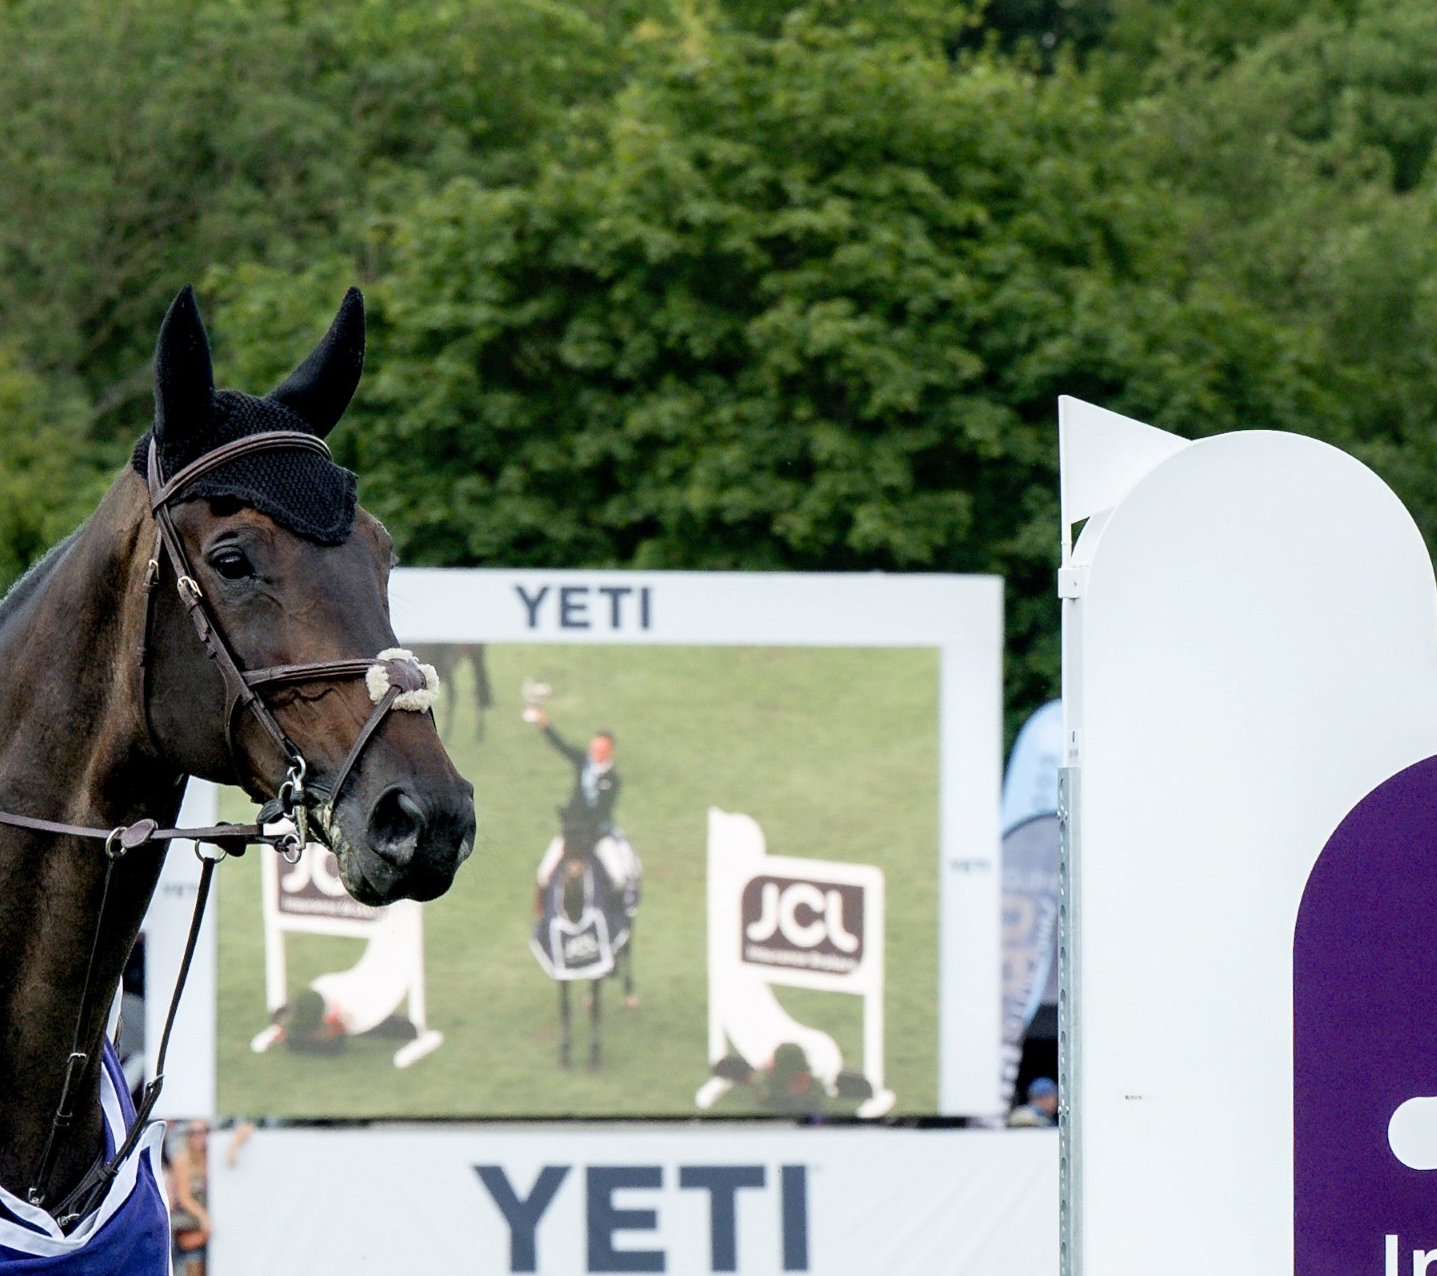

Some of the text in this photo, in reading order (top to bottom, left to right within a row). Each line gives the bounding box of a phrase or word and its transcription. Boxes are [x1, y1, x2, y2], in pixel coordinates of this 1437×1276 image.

[515, 585, 650, 629] YETI
[746, 882, 858, 953] JCL
[472, 1164, 809, 1274] YETI
